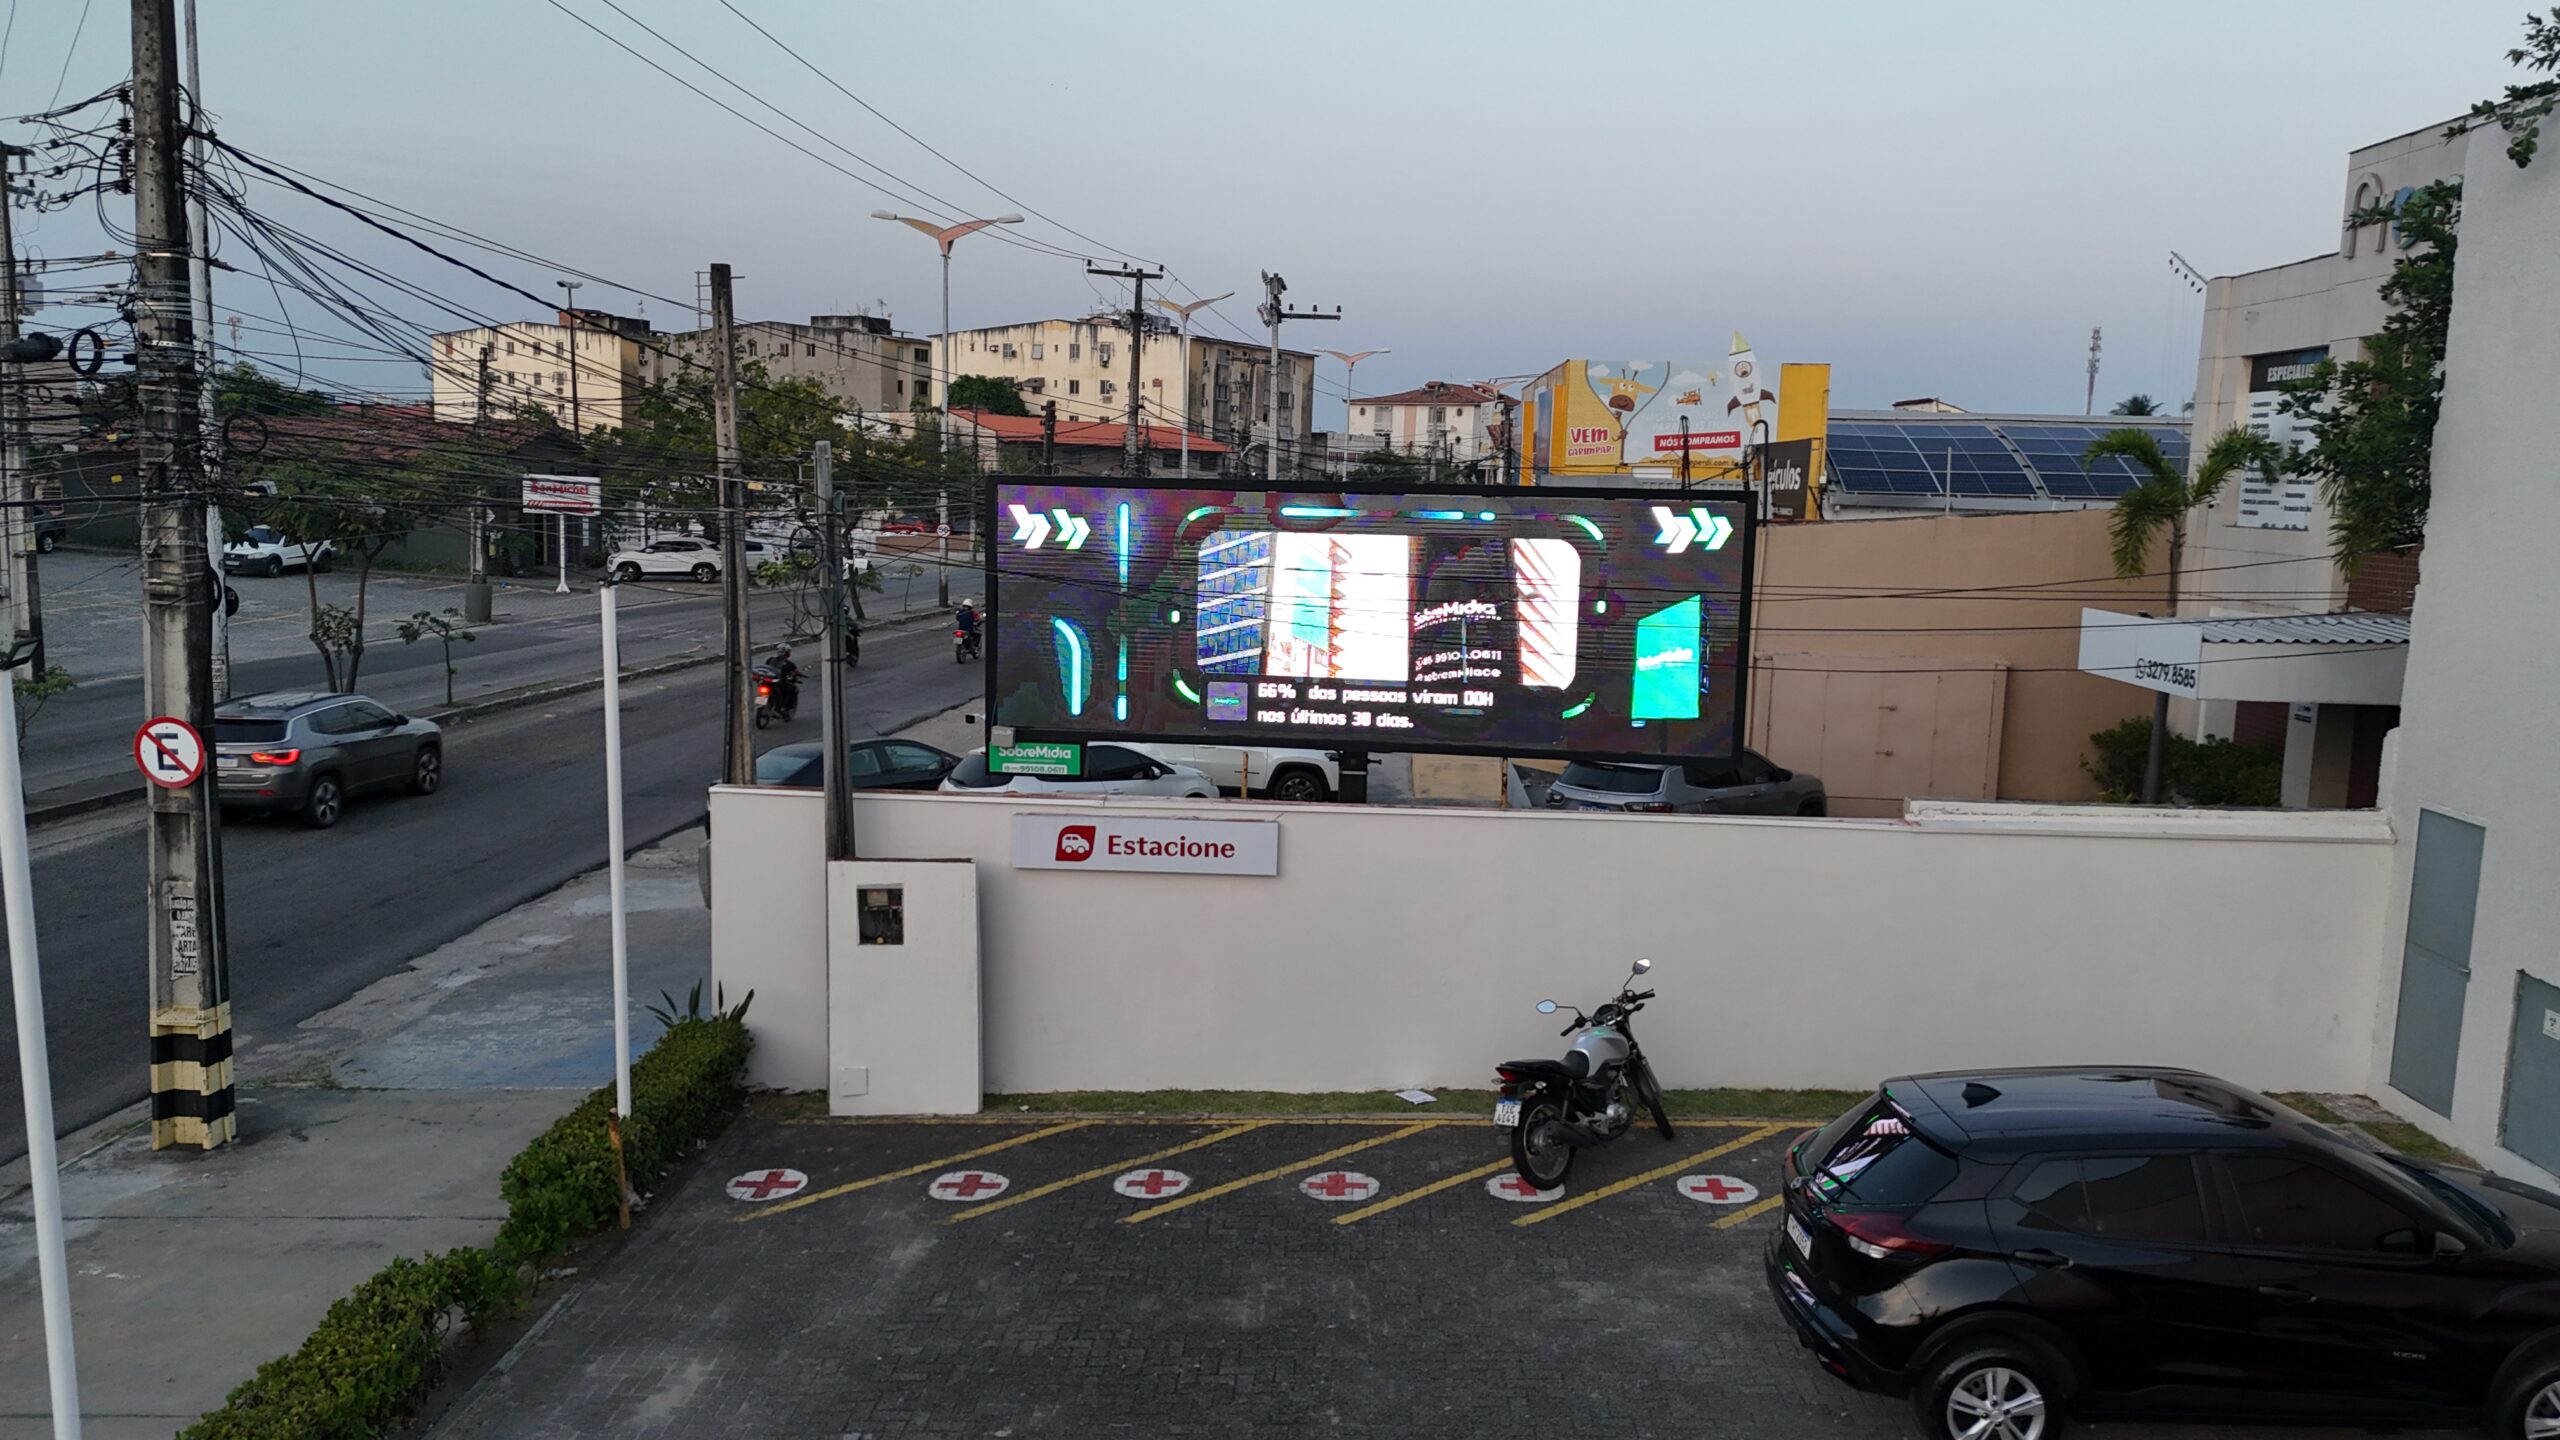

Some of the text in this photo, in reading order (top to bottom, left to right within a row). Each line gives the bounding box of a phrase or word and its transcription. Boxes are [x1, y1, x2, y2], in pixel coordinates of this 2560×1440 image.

[1570, 427, 1609, 443] VEM
[1659, 436, 1678, 447] NÓS
[2146, 660, 2196, 688] 3279.8585
[1258, 682, 1296, 699] 66%
[1308, 685, 1337, 700] das
[1342, 689, 1407, 704] pessoas
[1412, 689, 1458, 705] viram
[1257, 707, 1414, 728] nos últimos 30 dias.
[155, 732, 182, 771] E
[1108, 834, 1236, 858] Estacione
